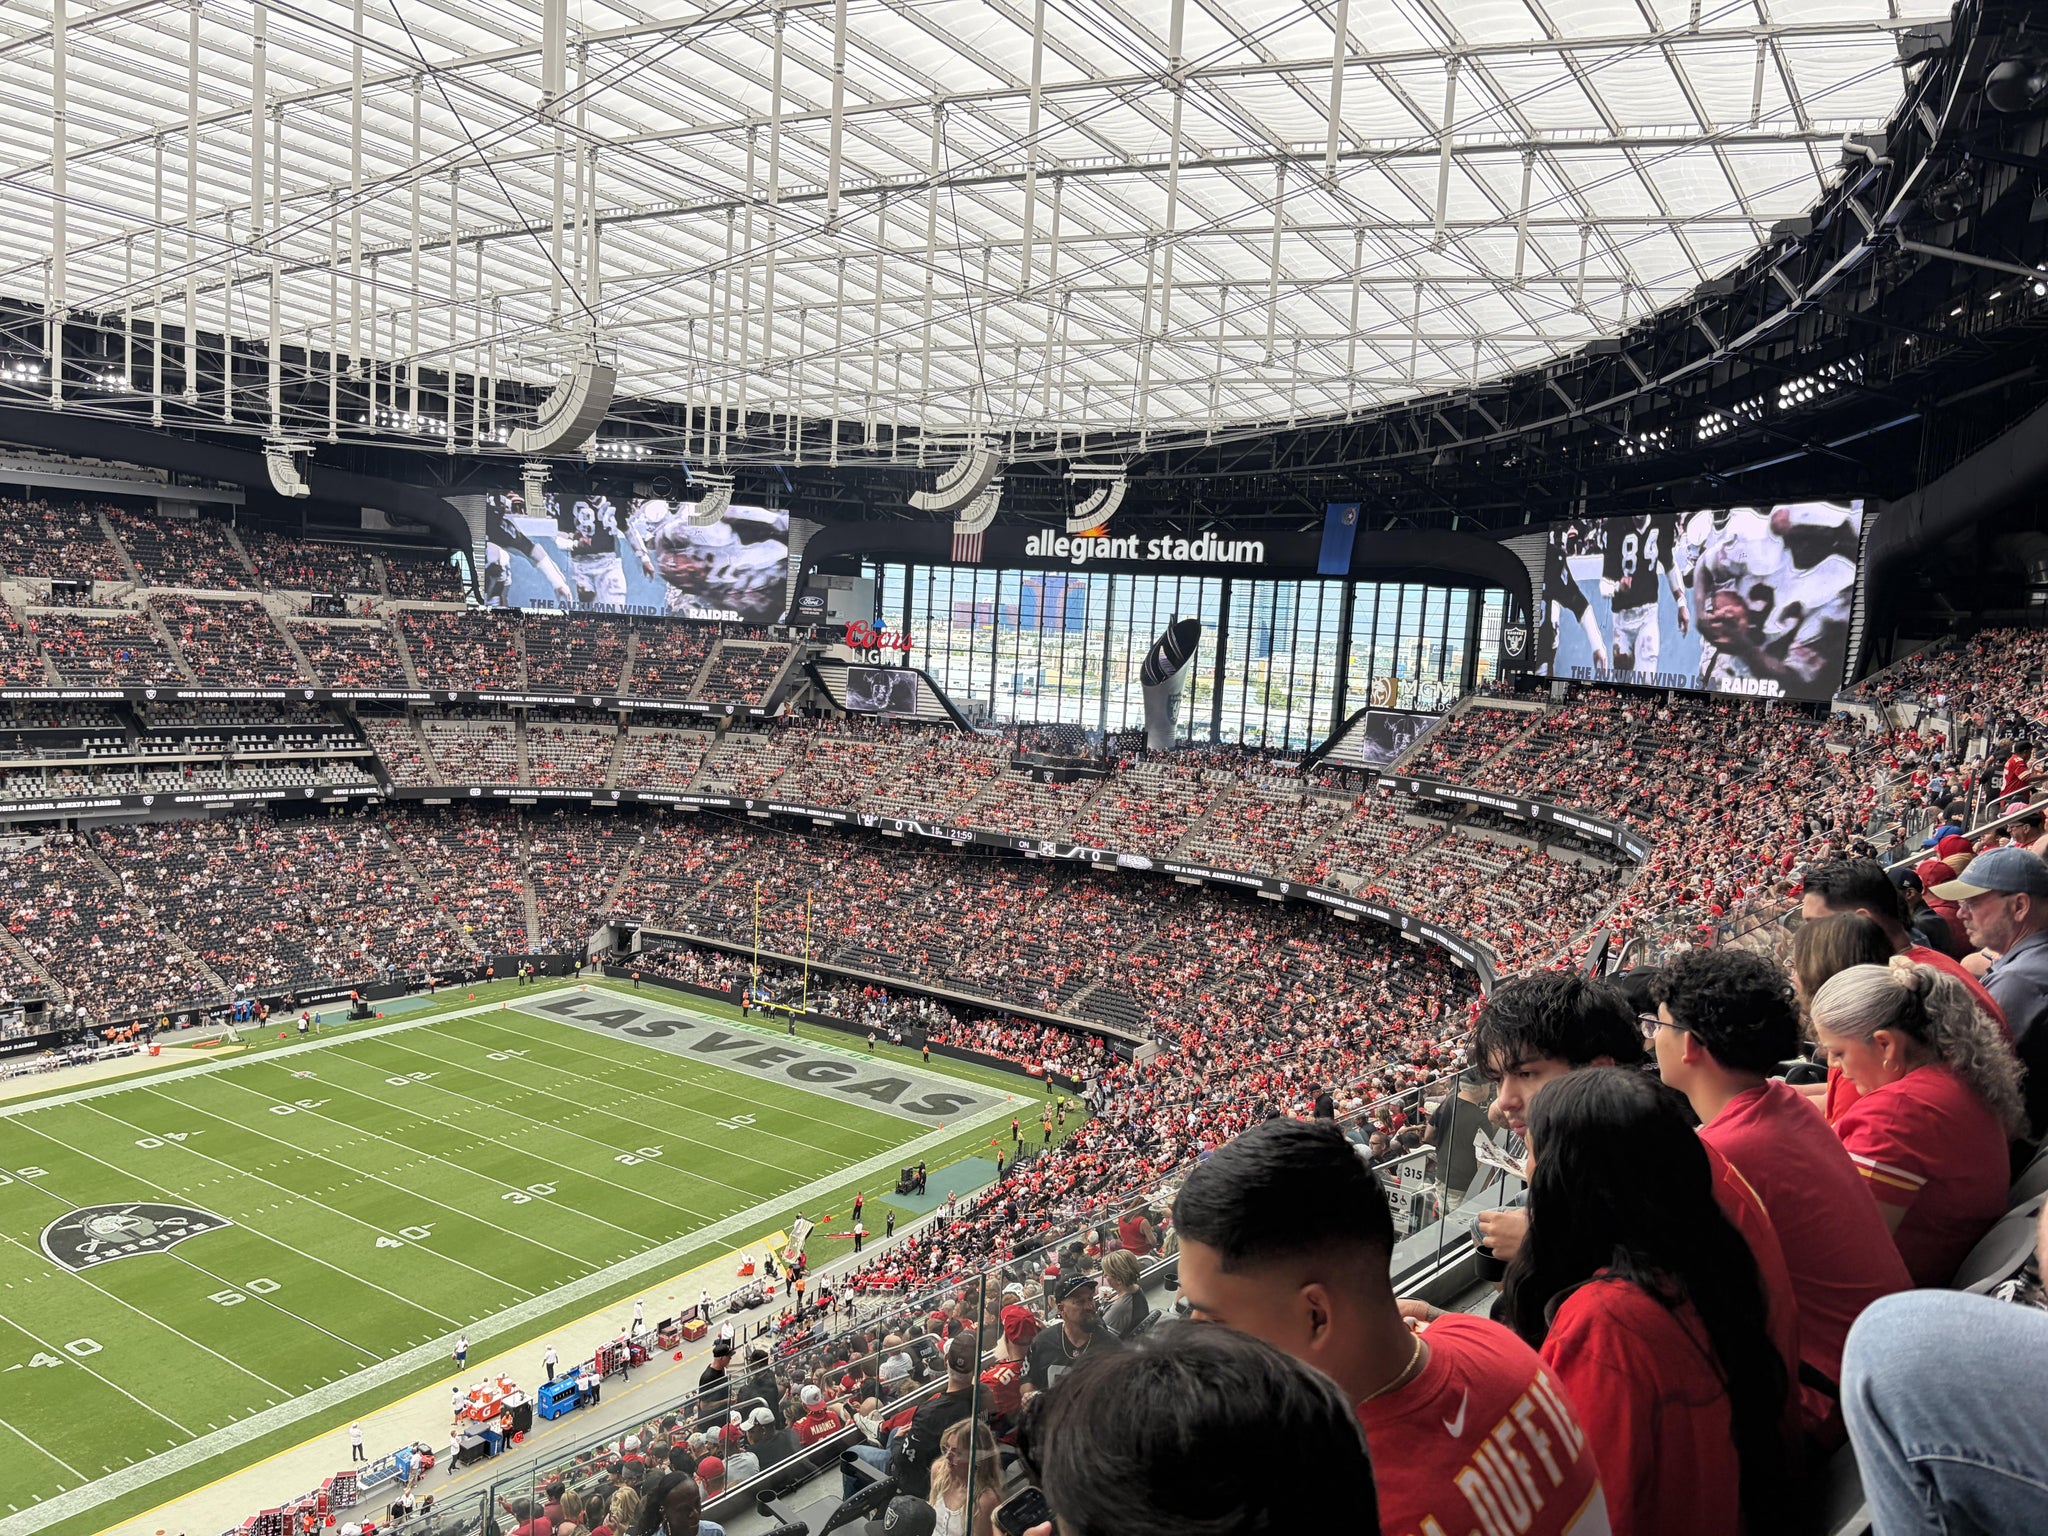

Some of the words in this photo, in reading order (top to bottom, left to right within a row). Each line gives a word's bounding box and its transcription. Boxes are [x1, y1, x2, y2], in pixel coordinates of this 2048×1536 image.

[1025, 529, 1139, 565] allegiant
[1147, 532, 1264, 563] stadium
[1622, 528, 1659, 575] 84
[530, 598, 554, 609] THE
[558, 600, 615, 613] AUTUMN
[620, 604, 657, 616] WIND
[689, 609, 744, 622] RAIDER,
[845, 620, 914, 651] Coors
[1401, 679, 1453, 700] MGM
[1571, 666, 1592, 680] THE
[1594, 668, 1647, 685] AUTUMN
[1650, 672, 1687, 689] WIND
[1721, 677, 1786, 697] RAIDER,
[1378, 779, 1396, 787] AIDER
[951, 830, 973, 840] 21:59
[1019, 841, 1029, 849] ON
[1041, 843, 1055, 855] 25
[1092, 852, 1100, 861] 0
[537, 997, 697, 1038] LAS
[688, 1031, 978, 1116] VEGAS
[385, 1071, 433, 1086] 20
[269, 1099, 322, 1115] 30
[716, 1115, 757, 1130] 10
[135, 1132, 188, 1149] 40
[614, 1147, 663, 1166] 20
[1404, 1167, 1422, 1180] 315
[501, 1183, 557, 1205] 30
[1387, 1191, 1398, 1203] 15
[84, 1222, 209, 1263] RAIDERS
[375, 1225, 432, 1248] 40
[206, 1278, 282, 1307] 50
[27, 1337, 104, 1369] 40
[993, 1366, 1016, 1385] 15
[483, 1406, 491, 1417] G
